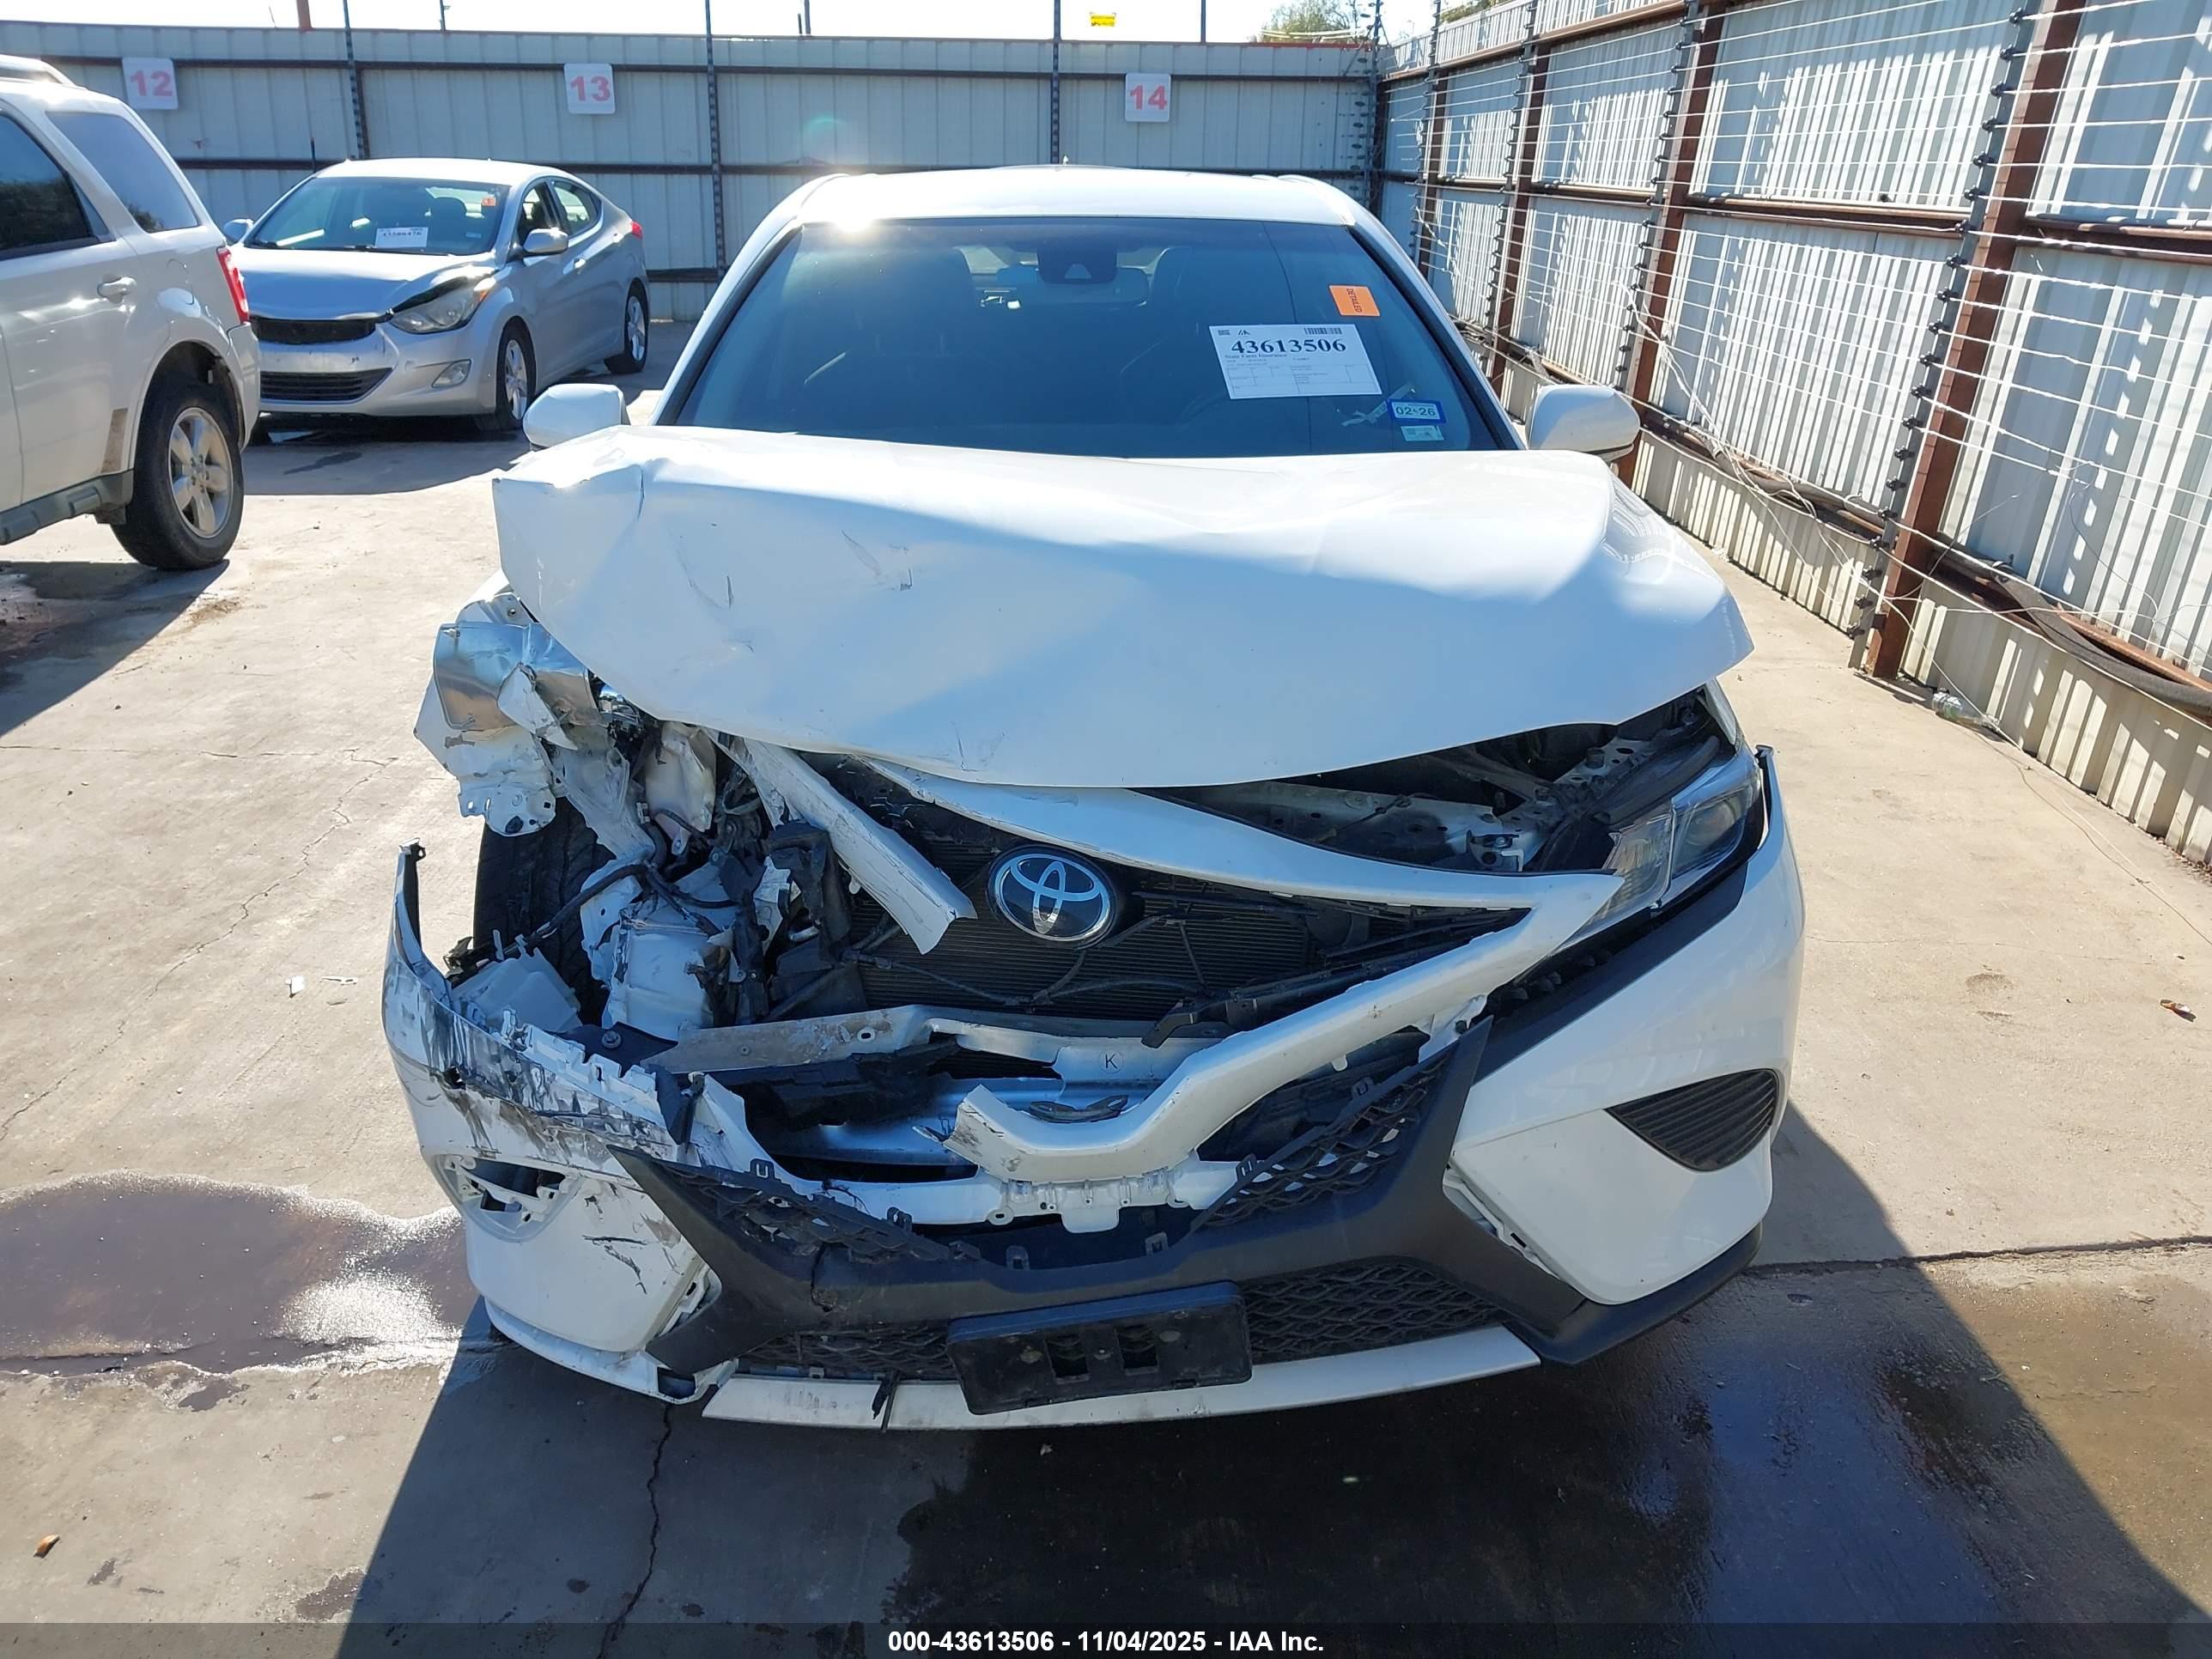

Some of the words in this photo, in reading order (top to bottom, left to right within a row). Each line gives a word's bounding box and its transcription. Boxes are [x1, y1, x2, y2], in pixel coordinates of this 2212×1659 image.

[130, 70, 173, 96] 12
[570, 76, 611, 101] 13
[1130, 84, 1168, 110] 14
[1346, 288, 1363, 313] DETAILED
[1231, 338, 1346, 354] 43613506
[1105, 1053, 1118, 1069] K
